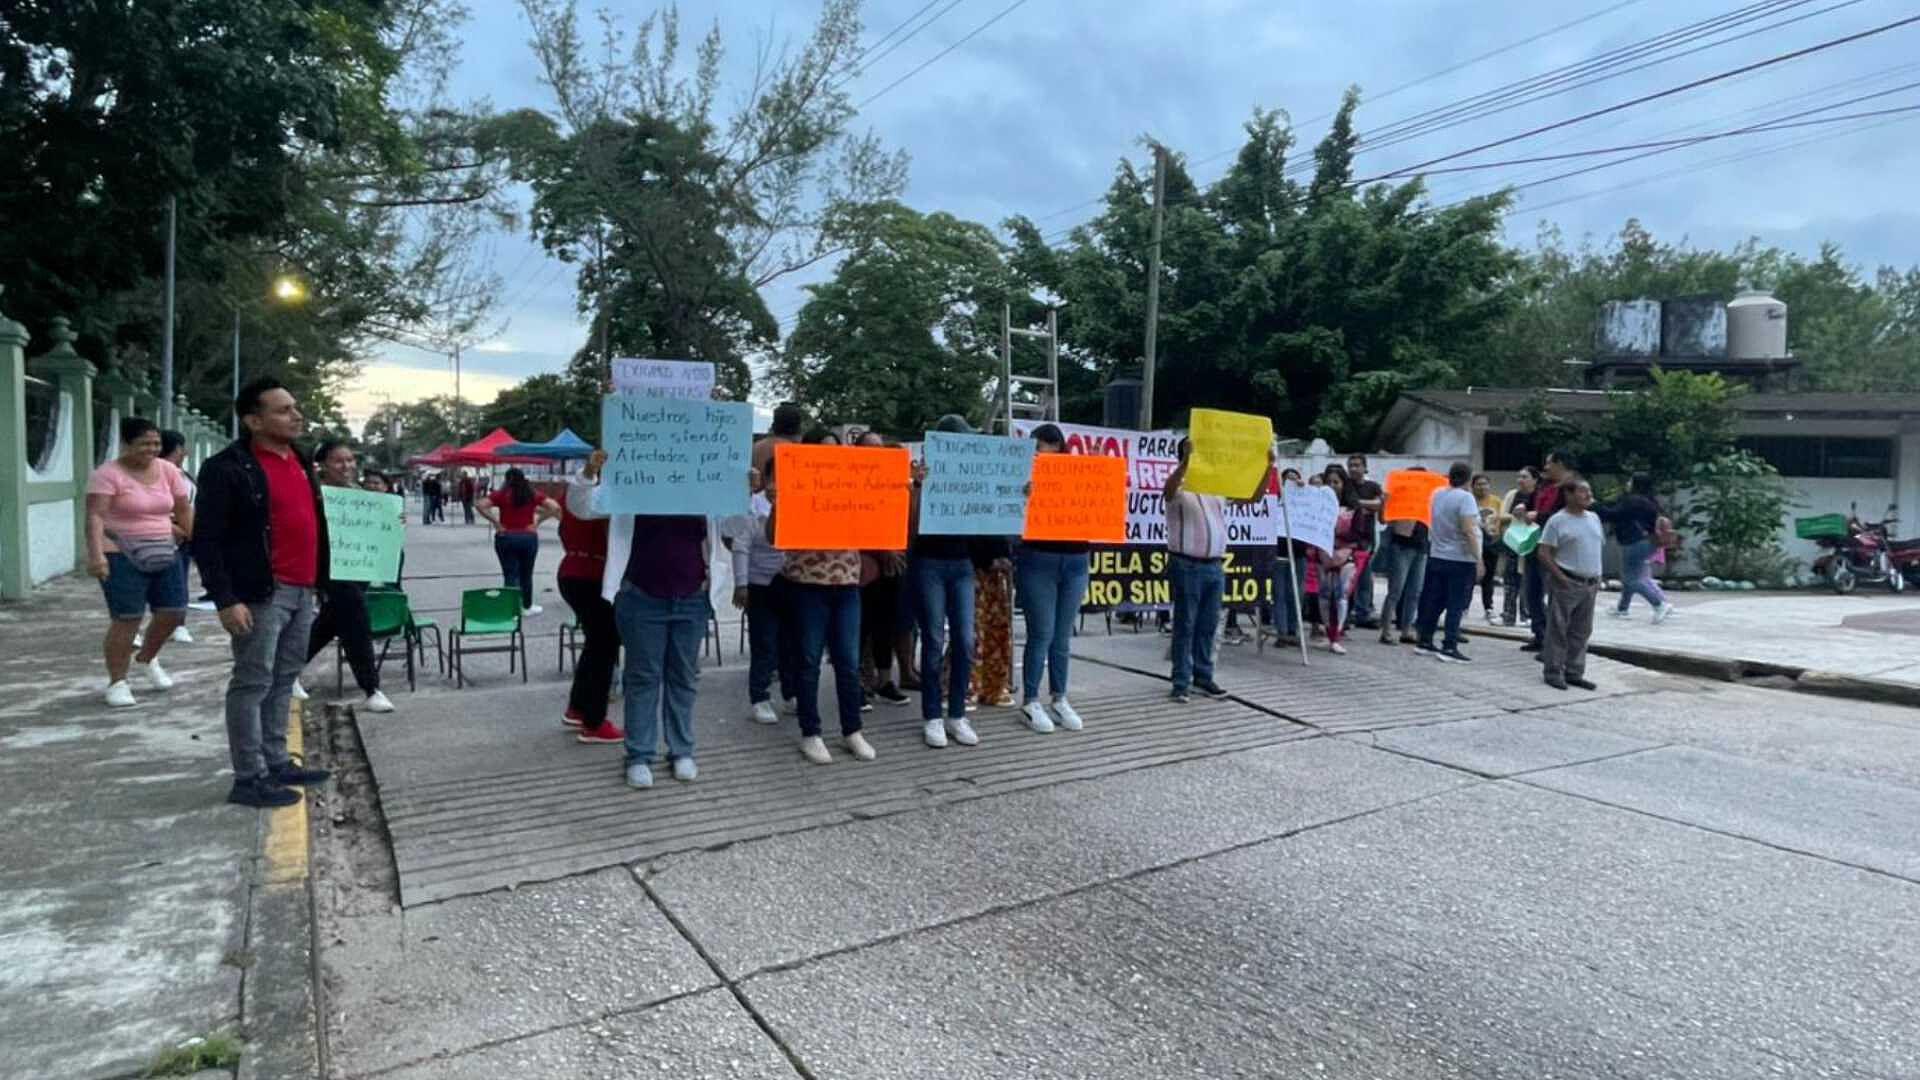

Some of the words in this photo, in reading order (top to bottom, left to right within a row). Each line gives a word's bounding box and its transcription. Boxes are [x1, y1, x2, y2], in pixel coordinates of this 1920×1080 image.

[621, 402, 691, 424] Nuestros
[704, 406, 738, 429] hijos
[700, 451, 721, 465] por
[728, 446, 740, 460] la
[1138, 436, 1178, 458] PARA
[614, 470, 656, 486] Falta
[667, 470, 687, 483] de
[1130, 579, 1170, 605] SIN
